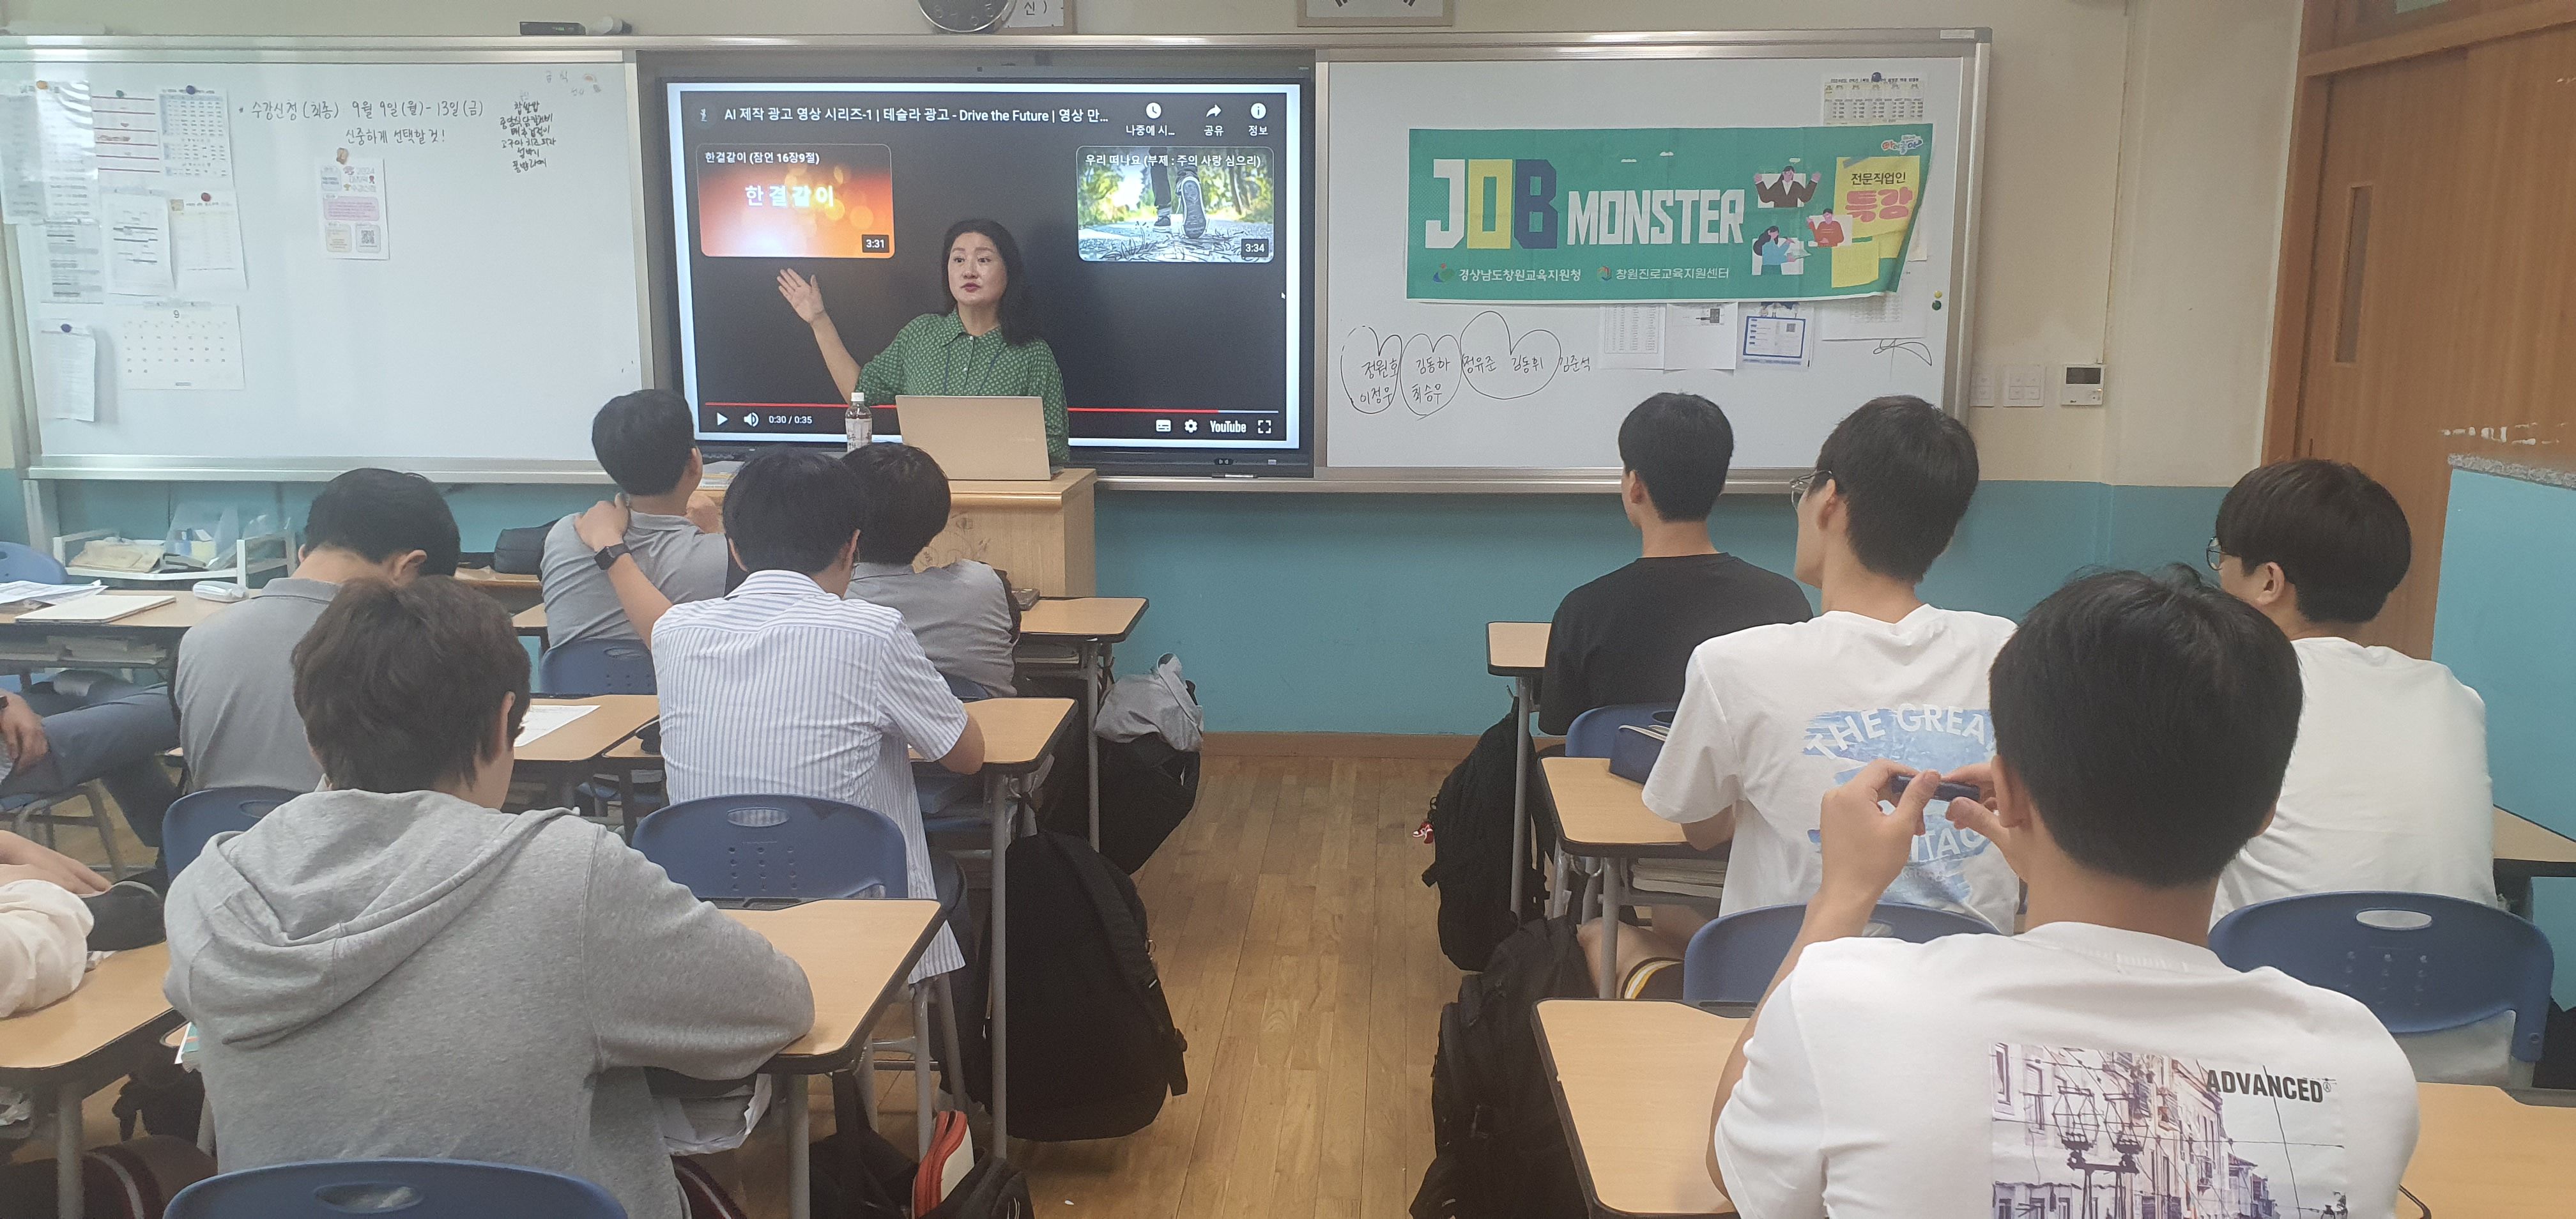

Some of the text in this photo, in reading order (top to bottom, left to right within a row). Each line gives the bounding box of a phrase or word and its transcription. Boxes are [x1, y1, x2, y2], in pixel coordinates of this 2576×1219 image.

[250, 101, 298, 119] 수강신청
[303, 100, 339, 119] (최종)
[352, 100, 374, 119] 9월
[436, 99, 484, 118] 13일(금)
[724, 109, 737, 121] AI
[740, 107, 765, 123] 제작
[768, 107, 793, 121] 광고
[797, 107, 822, 123] 영상
[825, 107, 873, 122] 시리즈-1
[884, 107, 921, 123] 테슬라
[924, 107, 950, 123] 광고
[960, 108, 988, 123] Drive
[991, 109, 1010, 123] the
[1013, 109, 1049, 123] Future
[1059, 109, 1084, 124] 영상
[346, 127, 446, 145] 신중하게 선택할 것!
[1126, 125, 1156, 137] 나중에
[1204, 125, 1224, 137] 공유
[1248, 125, 1269, 137] 정보
[705, 151, 747, 164] 한결같이
[776, 152, 820, 165] 16장9절)
[1085, 154, 1107, 166] 우리
[1109, 154, 1141, 167] 떠나요
[1144, 154, 1169, 168] (부제
[1177, 154, 1198, 167] 주의
[1201, 154, 1222, 167] 사랑
[1225, 154, 1261, 168] 심으리)
[1851, 172, 1906, 185] 전문직업인
[1425, 158, 1744, 249] JOB MONSTER
[1845, 187, 1913, 222] 특강
[866, 239, 885, 249] 3:31
[1245, 243, 1265, 253] 3:34
[1459, 268, 1581, 282] 경상남도창원교육지원청
[1616, 267, 1729, 280] 창원진로교육지원센터
[173, 309, 180, 319] 9
[1416, 356, 1451, 375] 김동하
[1462, 355, 1498, 374] 정유준
[1512, 355, 1544, 373] 김동휘
[1560, 355, 1591, 372] 김준석
[1360, 383, 1443, 406] 이정우 최승우
[769, 415, 786, 424] 0:30
[794, 415, 813, 425] 0:35
[1210, 420, 1246, 433] YouTube
[1806, 703, 1985, 760] THE GREA
[1911, 827, 1986, 862] ITAG
[2206, 1070, 2323, 1103] ADVANCED
